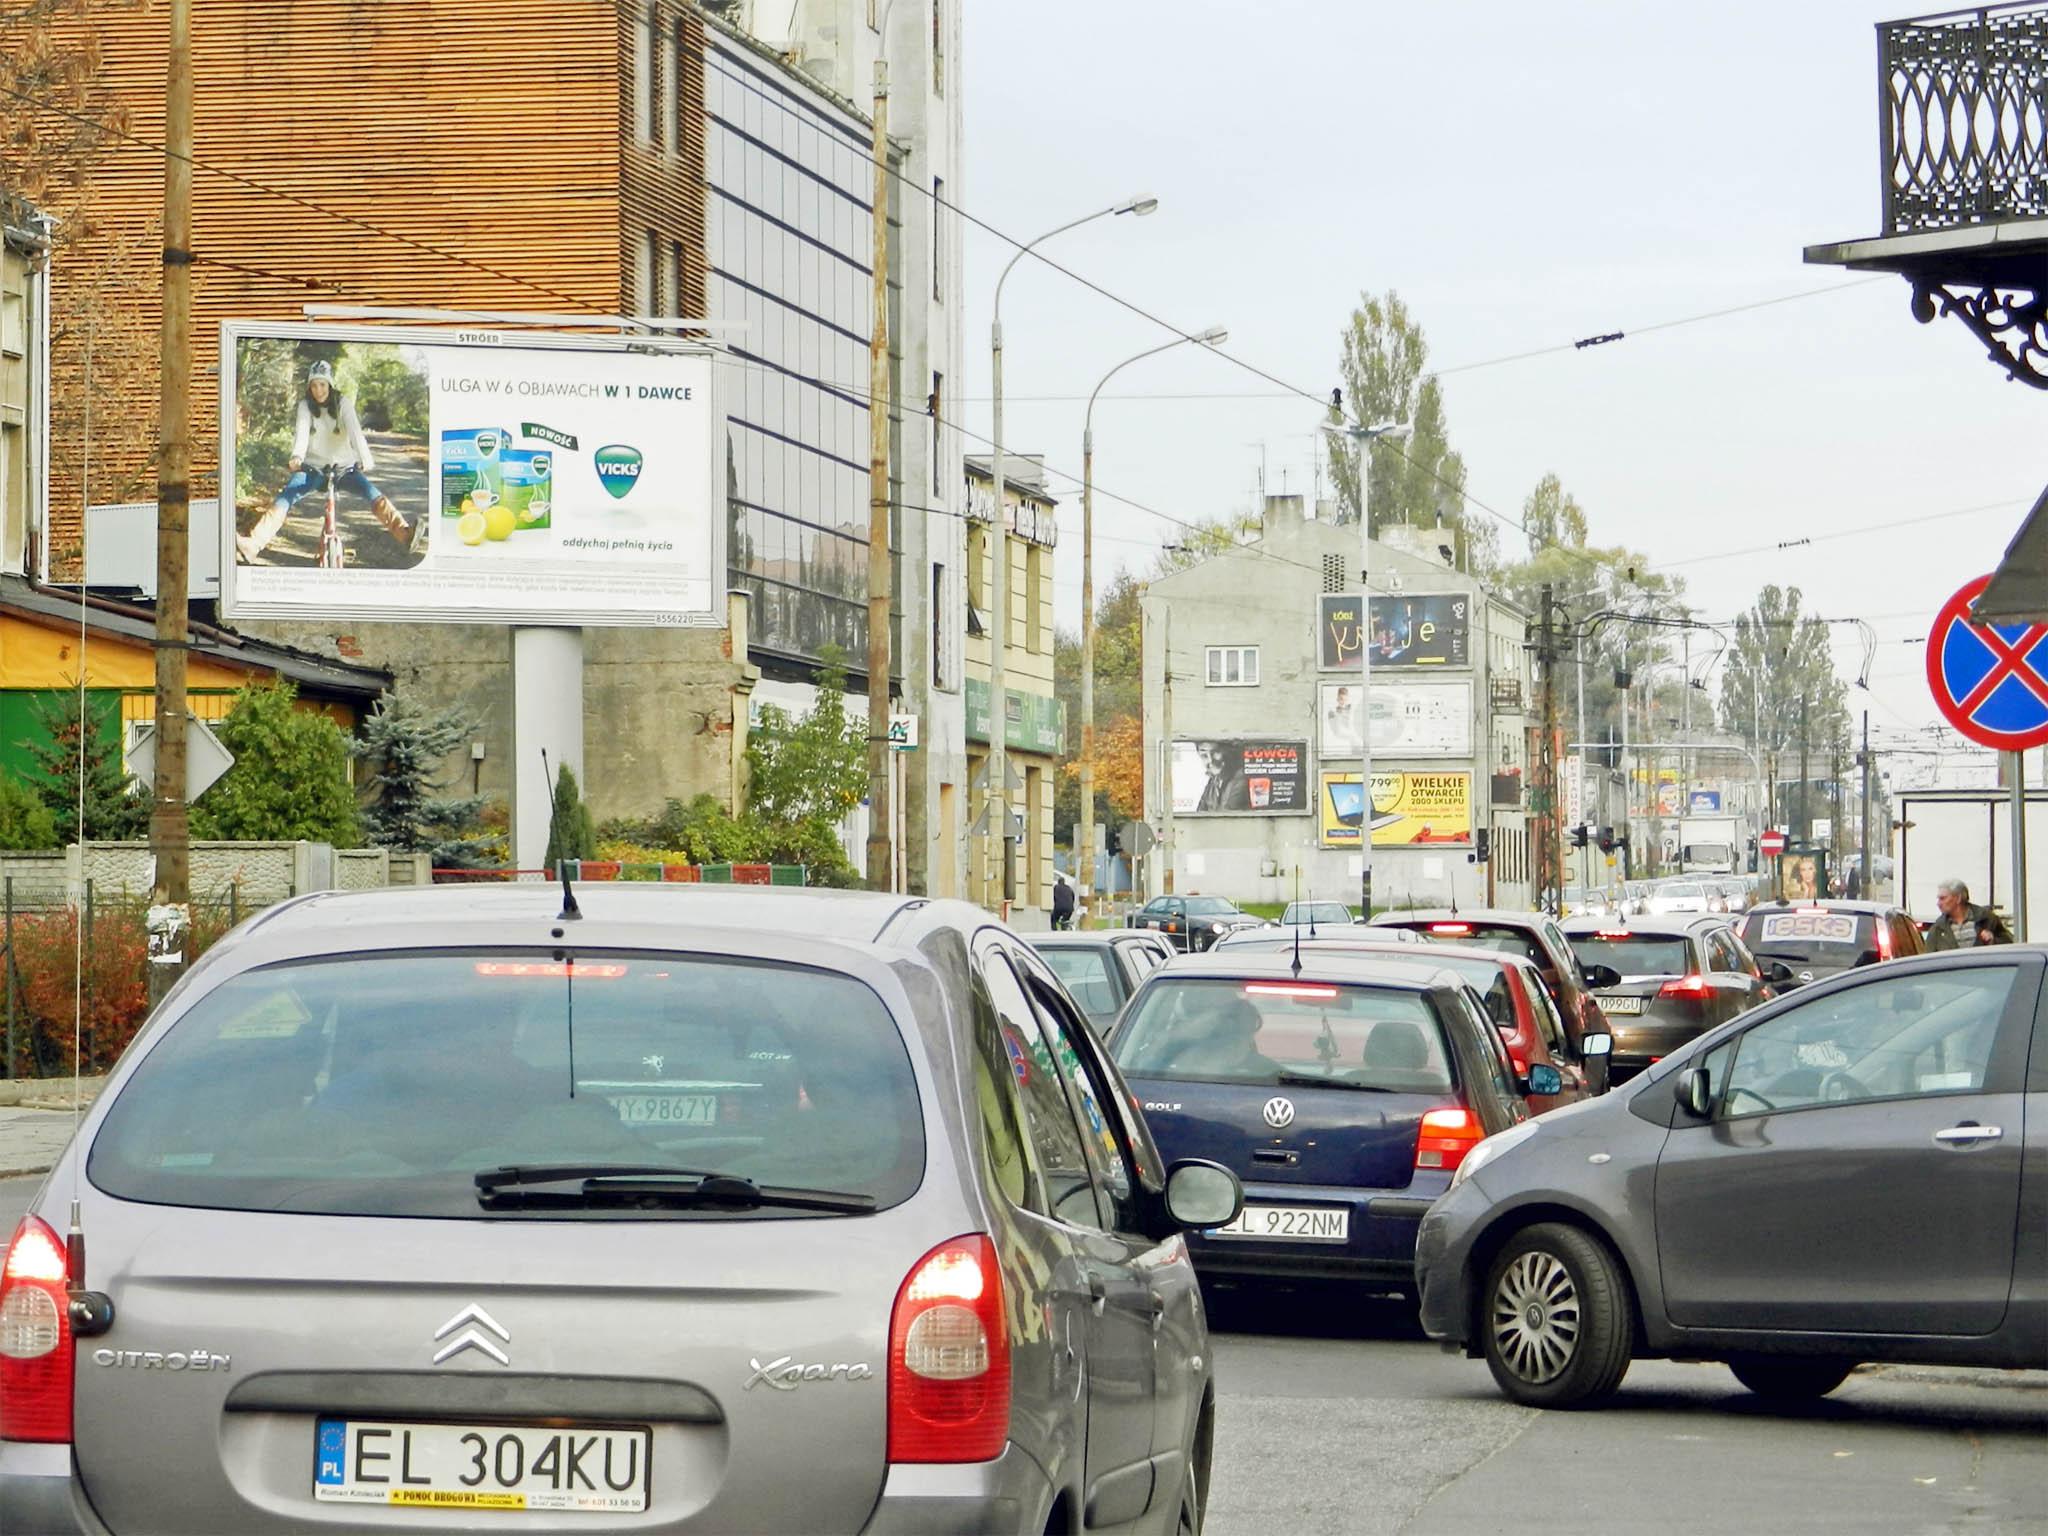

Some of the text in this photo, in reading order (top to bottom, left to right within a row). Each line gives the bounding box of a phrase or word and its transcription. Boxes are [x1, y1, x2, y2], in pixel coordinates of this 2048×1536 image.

[458, 333, 499, 344] STRÖER
[441, 379, 692, 400] ULGA W 6 OBJAWACH W 1 DAWCE
[530, 426, 573, 448] NOWOŚĆ
[599, 463, 638, 476] VICKS
[563, 538, 673, 551] oddychaj pełnią życia
[656, 614, 694, 624] 8556220
[1411, 777, 1464, 788] WIELKIE
[1410, 788, 1464, 797] OTWARCIE
[1434, 797, 1464, 805] SKLEPU
[646, 1097, 714, 1120] 9867Y
[1144, 1102, 1182, 1111] GOLF
[1267, 1211, 1343, 1236] 922NM
[92, 1348, 232, 1372] CITROËN
[742, 1355, 873, 1391] Xsara
[354, 1428, 637, 1492] EL 304KU
[322, 1461, 341, 1478] PL
[403, 1492, 476, 1503] POMOC DROGOWA
